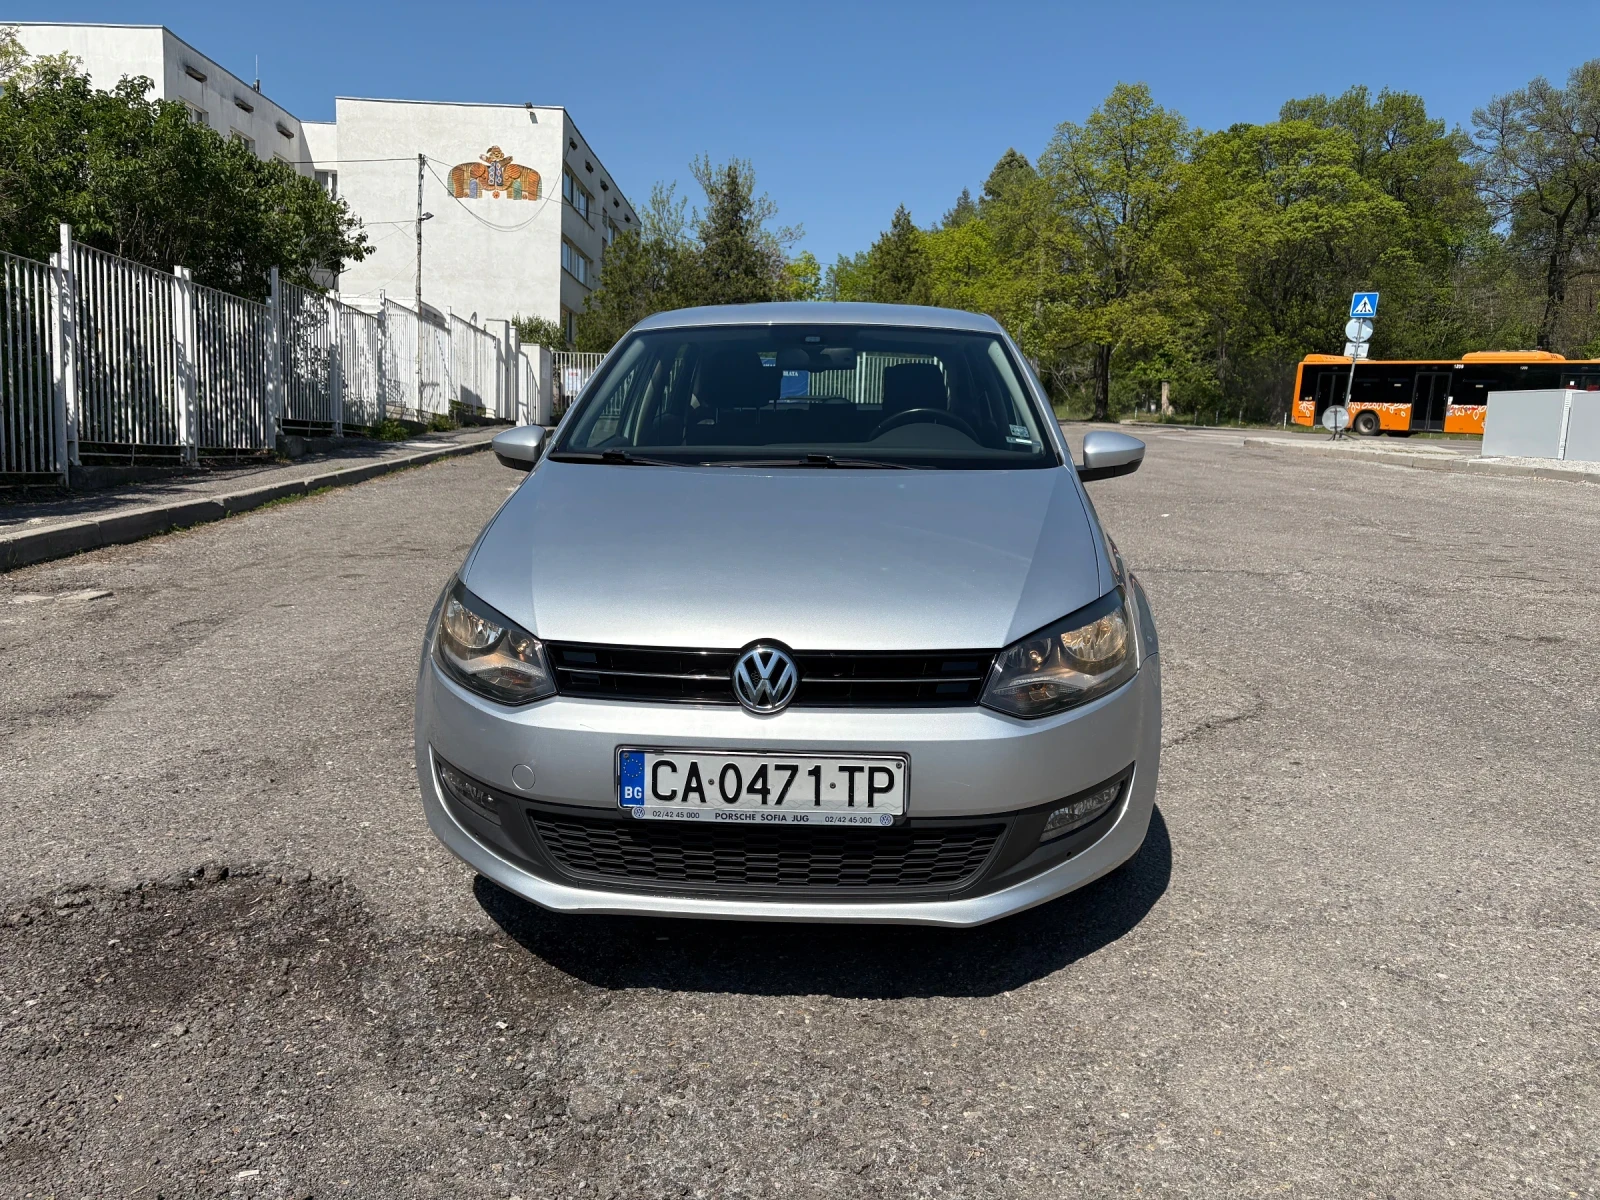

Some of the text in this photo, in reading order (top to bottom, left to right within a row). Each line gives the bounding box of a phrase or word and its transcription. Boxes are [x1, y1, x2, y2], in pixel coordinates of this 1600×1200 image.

[651, 759, 895, 808] CA 0471 TP
[624, 786, 642, 799] BG
[652, 810, 700, 819] 02/42 45 000
[714, 812, 810, 823] PORSCHE SOFIA JUG
[824, 816, 847, 824] 02/42
[848, 816, 858, 824] 45
